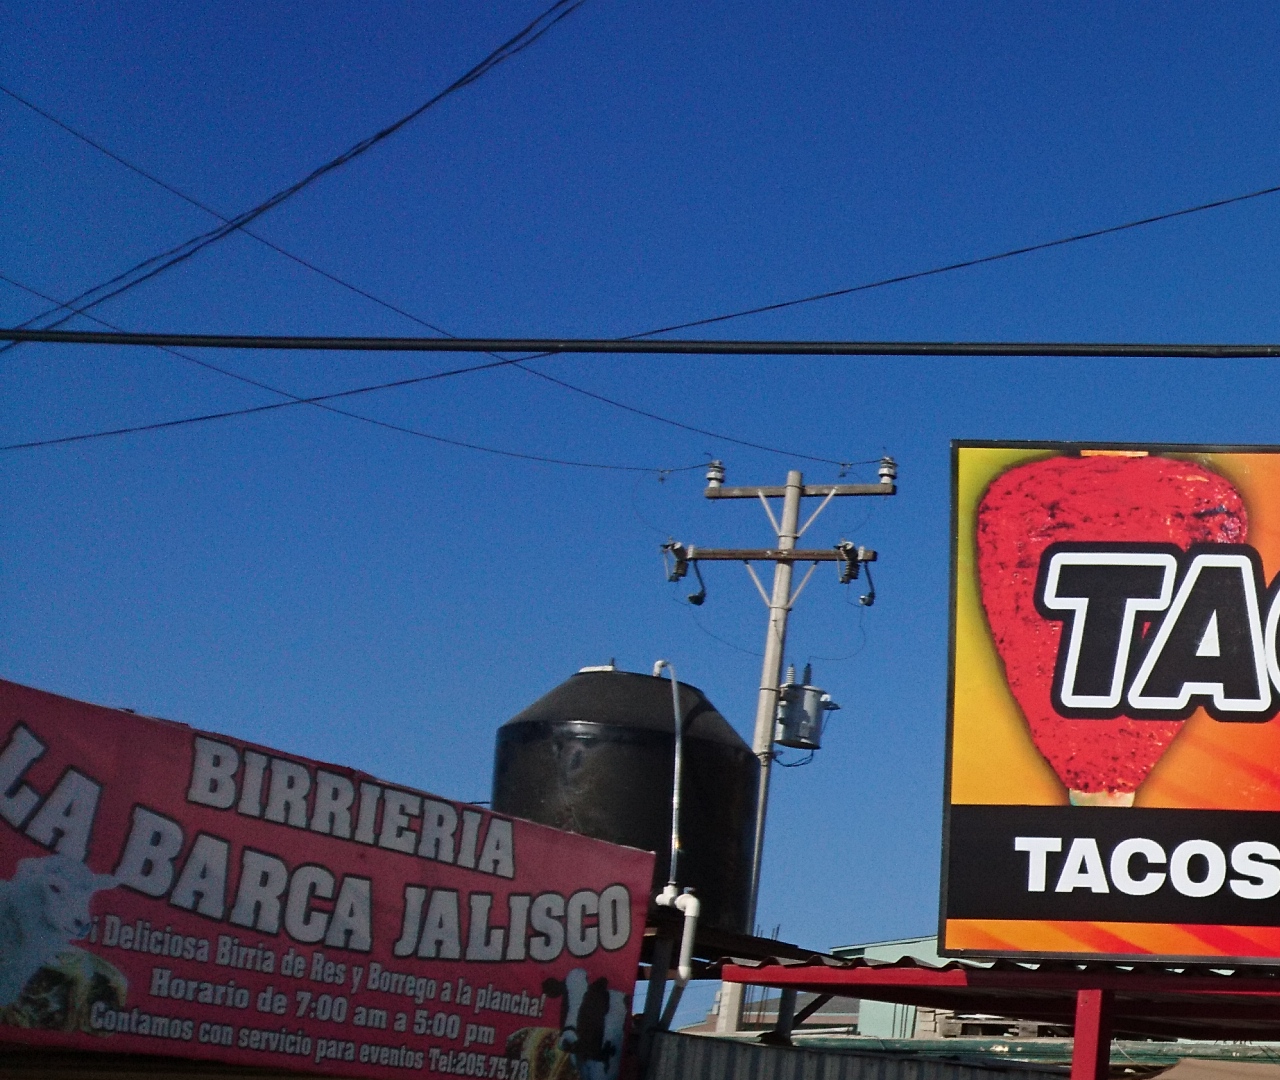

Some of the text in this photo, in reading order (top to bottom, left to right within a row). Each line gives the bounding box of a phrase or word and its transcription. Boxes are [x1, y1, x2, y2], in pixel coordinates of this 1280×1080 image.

[0, 720, 631, 963] LA BARCA JALISCO
[187, 733, 516, 880] BIRRIERIA
[102, 914, 210, 963] Deliciosa
[215, 934, 275, 974] Birria
[281, 946, 306, 978] de
[310, 951, 347, 985] Res
[350, 965, 364, 995] y
[366, 961, 437, 1004] Borrego
[440, 981, 453, 1003] a
[455, 977, 472, 1006] la
[474, 983, 547, 1018] plancha!
[150, 967, 496, 1048] Horario de 7:00 am a 5:00 pm
[90, 1000, 194, 1041] Contamos
[199, 1022, 233, 1046] con
[237, 1028, 312, 1055] servicio
[315, 1037, 355, 1064] para
[359, 1043, 424, 1071] eventos
